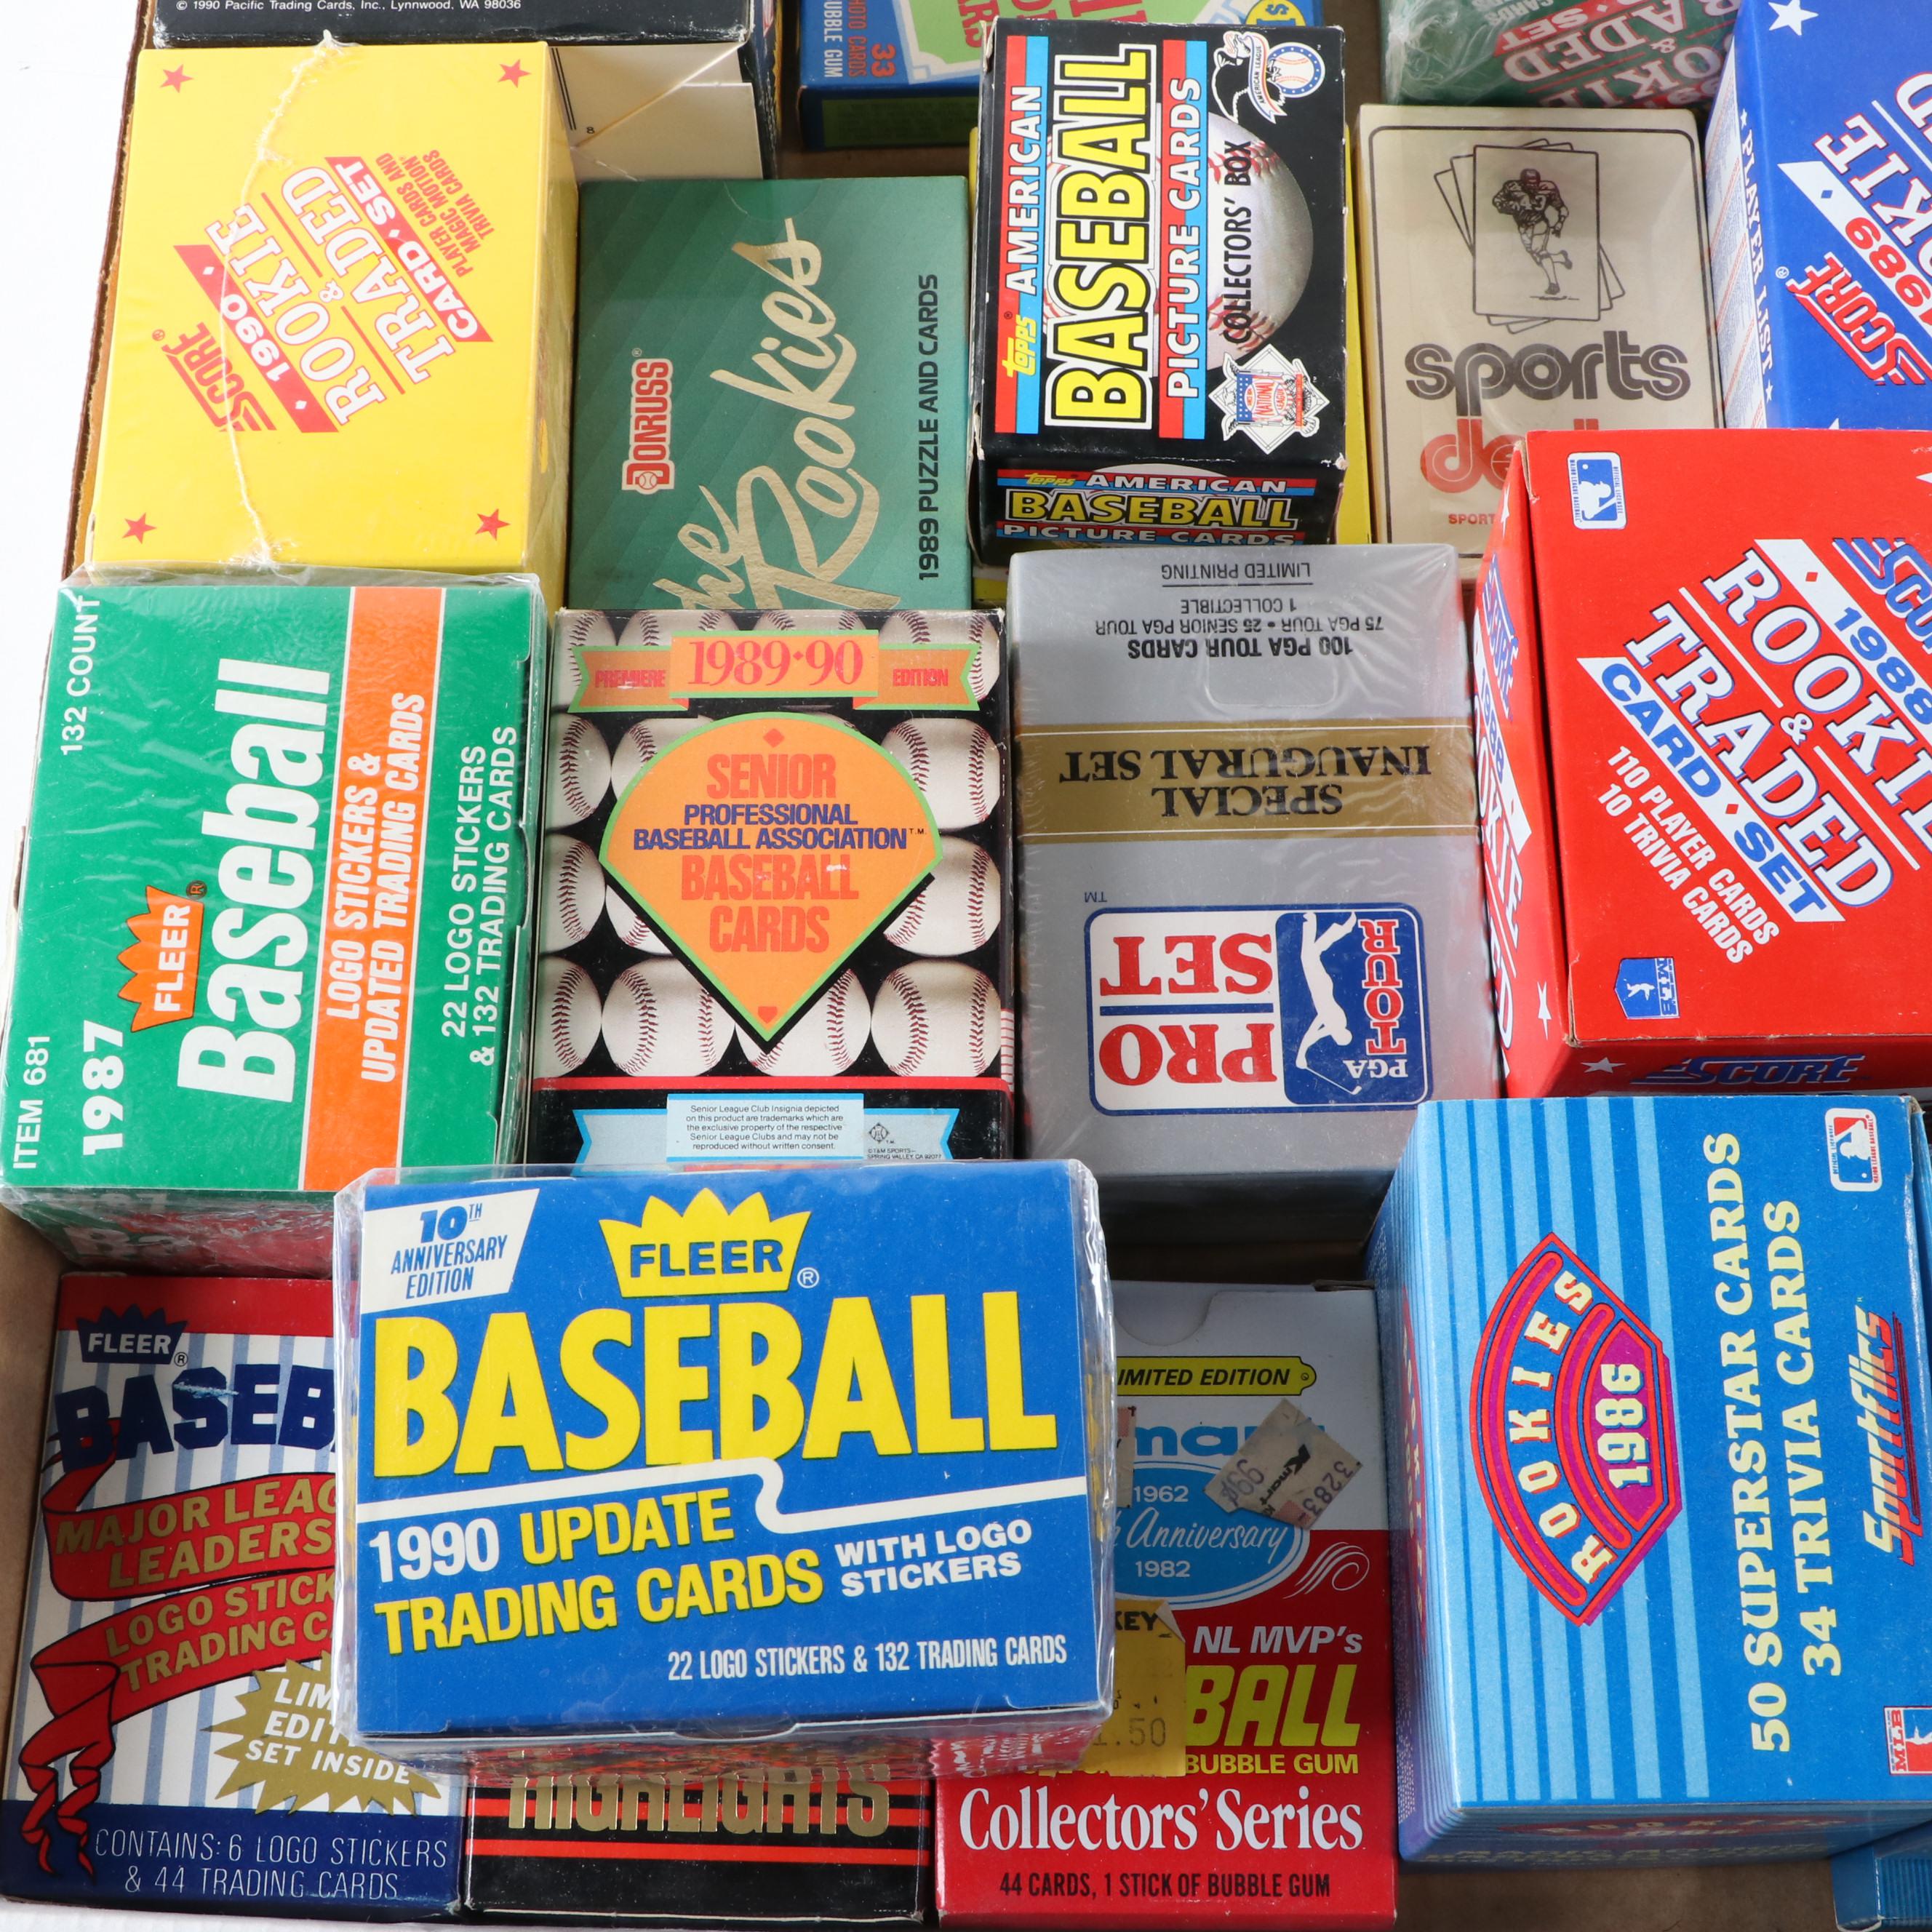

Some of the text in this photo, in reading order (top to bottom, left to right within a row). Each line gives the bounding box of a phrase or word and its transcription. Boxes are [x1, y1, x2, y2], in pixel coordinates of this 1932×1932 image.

[193, 0, 220, 10] 1990
[225, 0, 264, 10] Pacific
[269, 0, 311, 12] Trading
[317, 0, 355, 11] Cards,
[460, 0, 479, 9] WA
[484, 0, 522, 9] 98036
[823, 0, 843, 78] UBBLE GUM
[848, 0, 867, 78] HOTO CARDS
[871, 43, 896, 78] 33
[422, 150, 495, 240] TRIVIA CARDS
[1006, 85, 1042, 294] AMERICAN
[1224, 140, 1253, 188] BOX
[375, 153, 473, 278] PLAYER CARDS AND
[401, 156, 481, 254] MAGIC MOTION
[1050, 45, 1149, 427] BASEBALL
[1167, 76, 1201, 399] PICTURE CARDS
[281, 166, 455, 385] TRADED
[335, 161, 479, 339] CARD SET
[1741, 128, 1773, 375] PLAYER LIST
[204, 203, 388, 426] ROOKIE
[220, 293, 291, 382] 1990
[161, 322, 276, 431] SCORE
[1405, 331, 1691, 417] sports
[626, 360, 671, 489] DONRUSS
[918, 274, 939, 580] 1989 PUZZLE AND CARDS
[1162, 562, 1310, 580] LIMITED PRINTING
[1181, 598, 1297, 614] 1 COLLECTIBLE
[60, 596, 100, 756] 132 COUNT
[595, 670, 666, 687] PREMIERE
[892, 668, 949, 686] EDITION
[1127, 636, 1353, 659] 100 PGA TOUR CARDS
[706, 754, 837, 799] SENIOR
[1059, 746, 1431, 783] INAUGURAL SET
[1624, 600, 1893, 907] TRADED
[684, 803, 858, 826] PROFESSIONAL
[1151, 785, 1343, 817] SPECIAL
[1601, 663, 1827, 914] CARD SET
[634, 827, 749, 852] BASEBALL
[1608, 746, 1780, 945] 110 PLAYER CARDS
[177, 658, 331, 1103] Baseball
[325, 753, 380, 1020] LOGO STICKERS &
[361, 692, 425, 1082] UPDATED TRADING CARDS
[681, 853, 859, 901] BASEBALL
[1598, 783, 1753, 964] 10 TRIVIA CARDS
[154, 904, 190, 1012] FLEER
[710, 906, 829, 954] CARDS
[1100, 933, 1273, 995] SET
[1357, 919, 1406, 1055] TOUR
[1099, 1023, 1277, 1085] PRO
[1343, 1058, 1408, 1079] PGA
[1631, 1054, 1866, 1085] SCORE
[13, 1035, 51, 1169] ITEM 681
[82, 1020, 124, 1156] 1987
[691, 1105, 839, 1114] Senior League Club Insignia depicted
[698, 1114, 712, 1122] this
[714, 1114, 744, 1123] product
[760, 1114, 804, 1122] trademarks
[806, 1114, 829, 1122] which
[391, 1235, 507, 1274] ANNIVERSARY
[405, 1266, 474, 1299] EDITION
[630, 1240, 783, 1278] FLEER
[88, 1333, 172, 1354] FLEER
[374, 1290, 1058, 1479] BASEBALL
[1200, 1368, 1290, 1386] EDITION
[1508, 1271, 1617, 1583] ROOKIES
[1595, 1364, 1650, 1489] 1986
[1702, 1133, 1790, 1752] 50 SUPERSTAR CARDS
[1763, 1200, 1841, 1676] 34 TRIVIA CARDS
[55, 1496, 210, 1554] MAJOR
[1133, 1485, 1189, 1503] 1962
[109, 1518, 332, 1590] LEADERS
[368, 1487, 733, 1583] 1990 UPDATE
[836, 1517, 1032, 1567] WITH LOGO
[1126, 1506, 1287, 1563] Anniversary
[840, 1551, 1021, 1597] STICKERS
[1135, 1561, 1191, 1577] 1982
[105, 1595, 213, 1657] LOGO
[374, 1549, 823, 1656] TRADING CARDS
[120, 1616, 295, 1693] TRADING
[1193, 1626, 1362, 1655] NL MVP's
[245, 1741, 410, 1785] SET INSIDE
[1186, 1754, 1359, 1775] BUBBLE GUM
[95, 1829, 447, 1868] CONTAINS: 6 LOGO STICKERS
[1216, 1786, 1362, 1851] Series
[999, 1872, 1330, 1899] 44 CARDS, 1 STICK OF BUBBLE GUM
